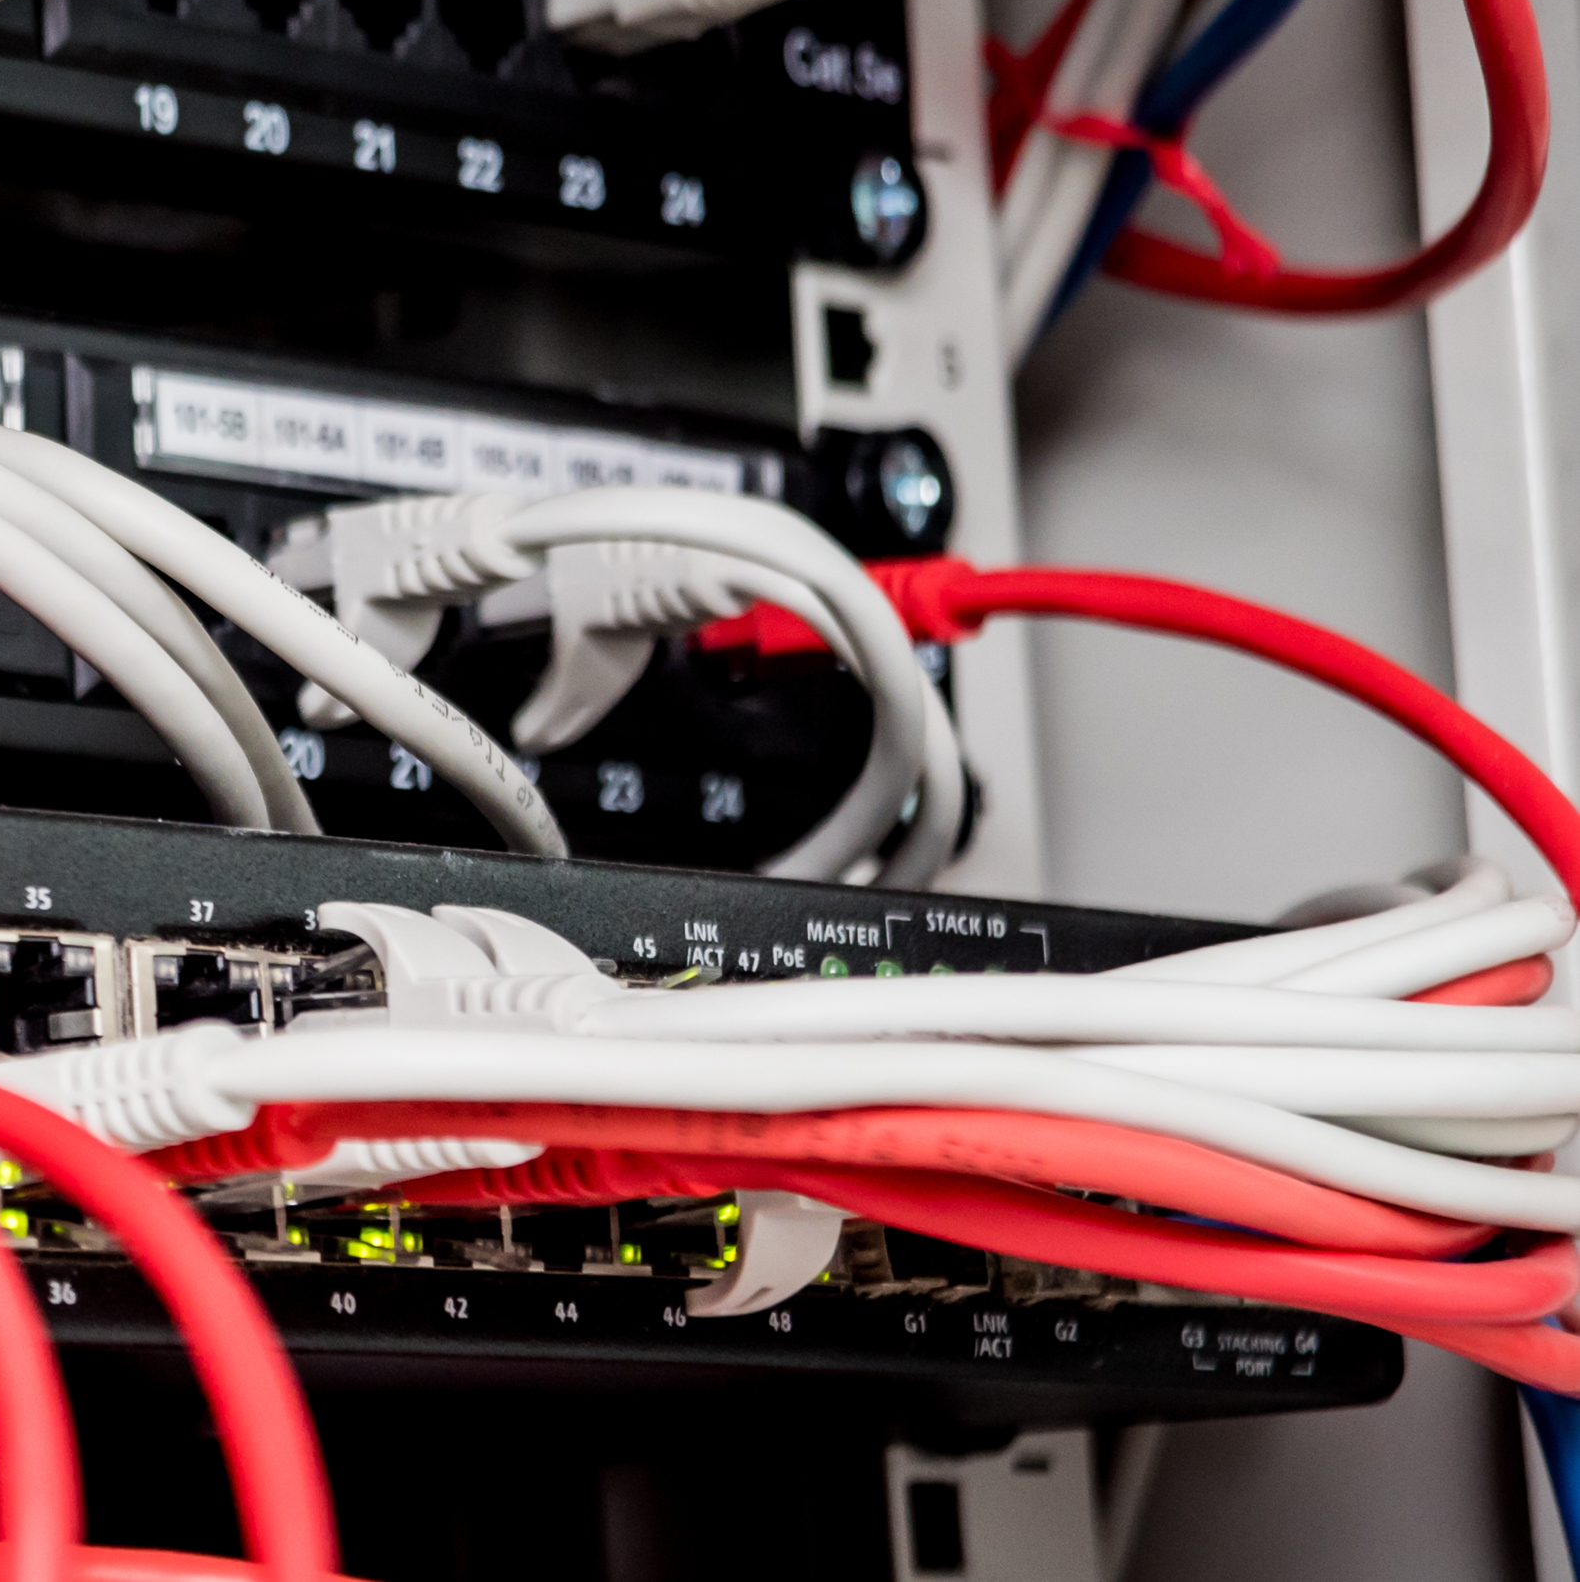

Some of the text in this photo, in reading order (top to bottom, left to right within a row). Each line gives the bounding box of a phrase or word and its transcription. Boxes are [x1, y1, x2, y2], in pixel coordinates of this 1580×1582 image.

[134, 85, 179, 135] 19
[243, 101, 290, 155] 20
[353, 120, 396, 172] 21
[457, 138, 503, 193] 22
[559, 157, 606, 210] 23
[662, 177, 705, 225] 24
[599, 765, 644, 813] 23
[703, 777, 743, 822] 24
[24, 885, 53, 911] 35
[189, 899, 215, 923] 37
[632, 911, 1006, 959] 45 LNK MASTER STACK ID
[686, 944, 806, 973] /ACT 47 PoE
[48, 1280, 77, 1305] 36
[330, 1291, 357, 1315] 40
[444, 1296, 469, 1319] 42
[554, 1301, 579, 1323] 44
[662, 1306, 687, 1328] 46
[768, 1311, 792, 1333] 48
[904, 1313, 926, 1334] G1
[973, 1312, 1009, 1336] LNK
[1054, 1320, 1078, 1342] G2
[1181, 1325, 1205, 1349] G3
[973, 1336, 1014, 1360] /ACT
